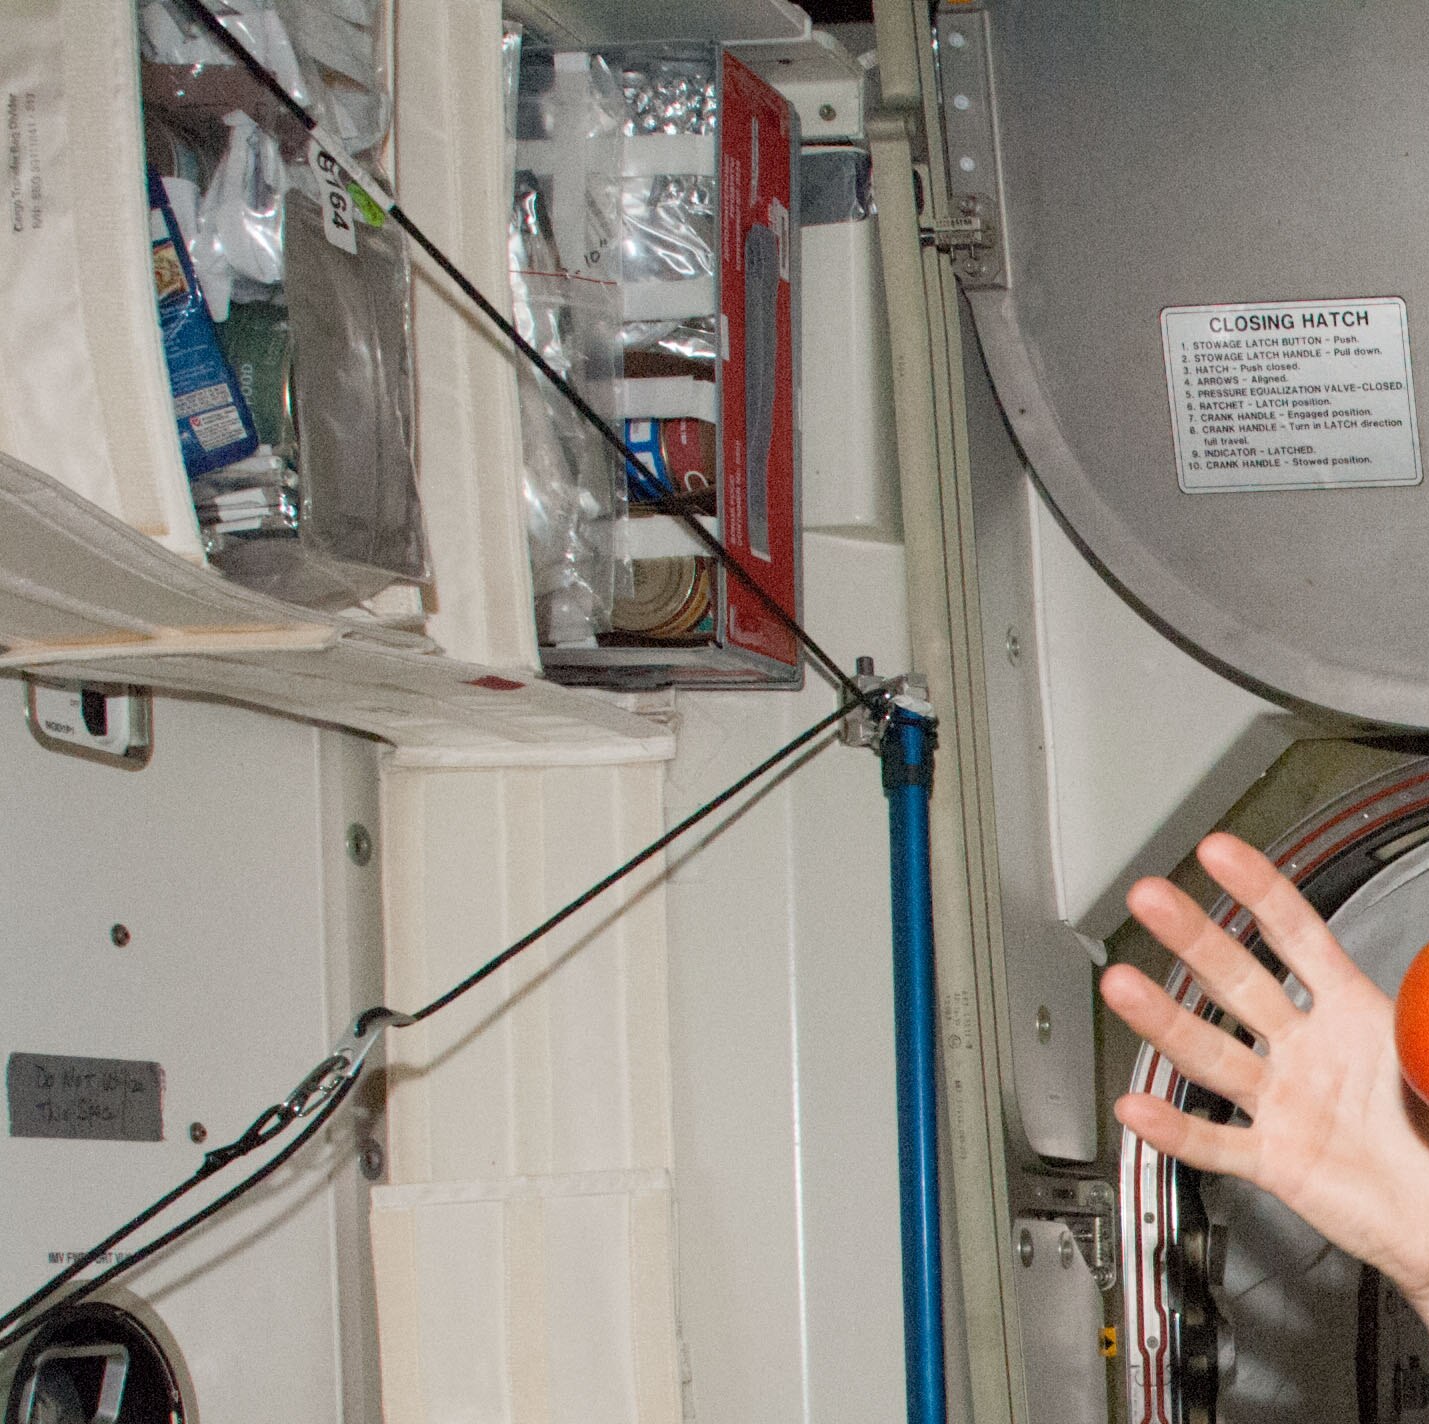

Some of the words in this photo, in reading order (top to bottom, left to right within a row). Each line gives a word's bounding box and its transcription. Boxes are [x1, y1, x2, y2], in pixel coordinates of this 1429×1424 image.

[312, 150, 350, 234] B164
[1209, 314, 1295, 333] CLOSING
[1302, 311, 1370, 329] HATCH
[1193, 340, 1242, 350] STOWAGE
[1246, 338, 1279, 348] LATCH
[1281, 336, 1322, 346] BUTTON
[1333, 336, 1360, 345] Push.
[1194, 353, 1244, 363] STOWAGE
[1247, 351, 1280, 360] LATCH
[1283, 349, 1322, 358] HANDLE
[1333, 348, 1352, 356] Pull
[1354, 347, 1382, 355] down.
[1195, 365, 1229, 374] HATCH
[1240, 364, 1263, 372] Push
[1266, 362, 1300, 371] closed.
[1197, 376, 1239, 385] ARROWS
[1251, 375, 1288, 385] Aligned.
[1197, 387, 1248, 397] PRESSURE
[1250, 384, 1322, 394] EQUALIZATION
[1199, 400, 1244, 410] RATCHET
[1256, 399, 1289, 408] LATCH
[1292, 398, 1332, 408] position.
[1200, 412, 1234, 422] CRANK
[1237, 411, 1276, 420] HANDLE
[1287, 409, 1329, 419] Engaged
[1332, 407, 1372, 418] position.
[1202, 424, 1235, 434] CRANK
[1239, 422, 1277, 432] HANDLE
[1289, 421, 1311, 431] Turn
[1314, 421, 1322, 429] in
[1324, 419, 1357, 429] LATCH
[1360, 418, 1403, 427] direction
[1203, 436, 1218, 445] full
[1220, 436, 1248, 445] travel.
[1204, 448, 1257, 457] INDICATOR
[1267, 446, 1317, 455] LATCHED.
[1206, 460, 1239, 469] CRANK
[1242, 458, 1281, 468] HANDLE
[1292, 457, 1329, 466] Stowed
[1331, 456, 1373, 466] position.
